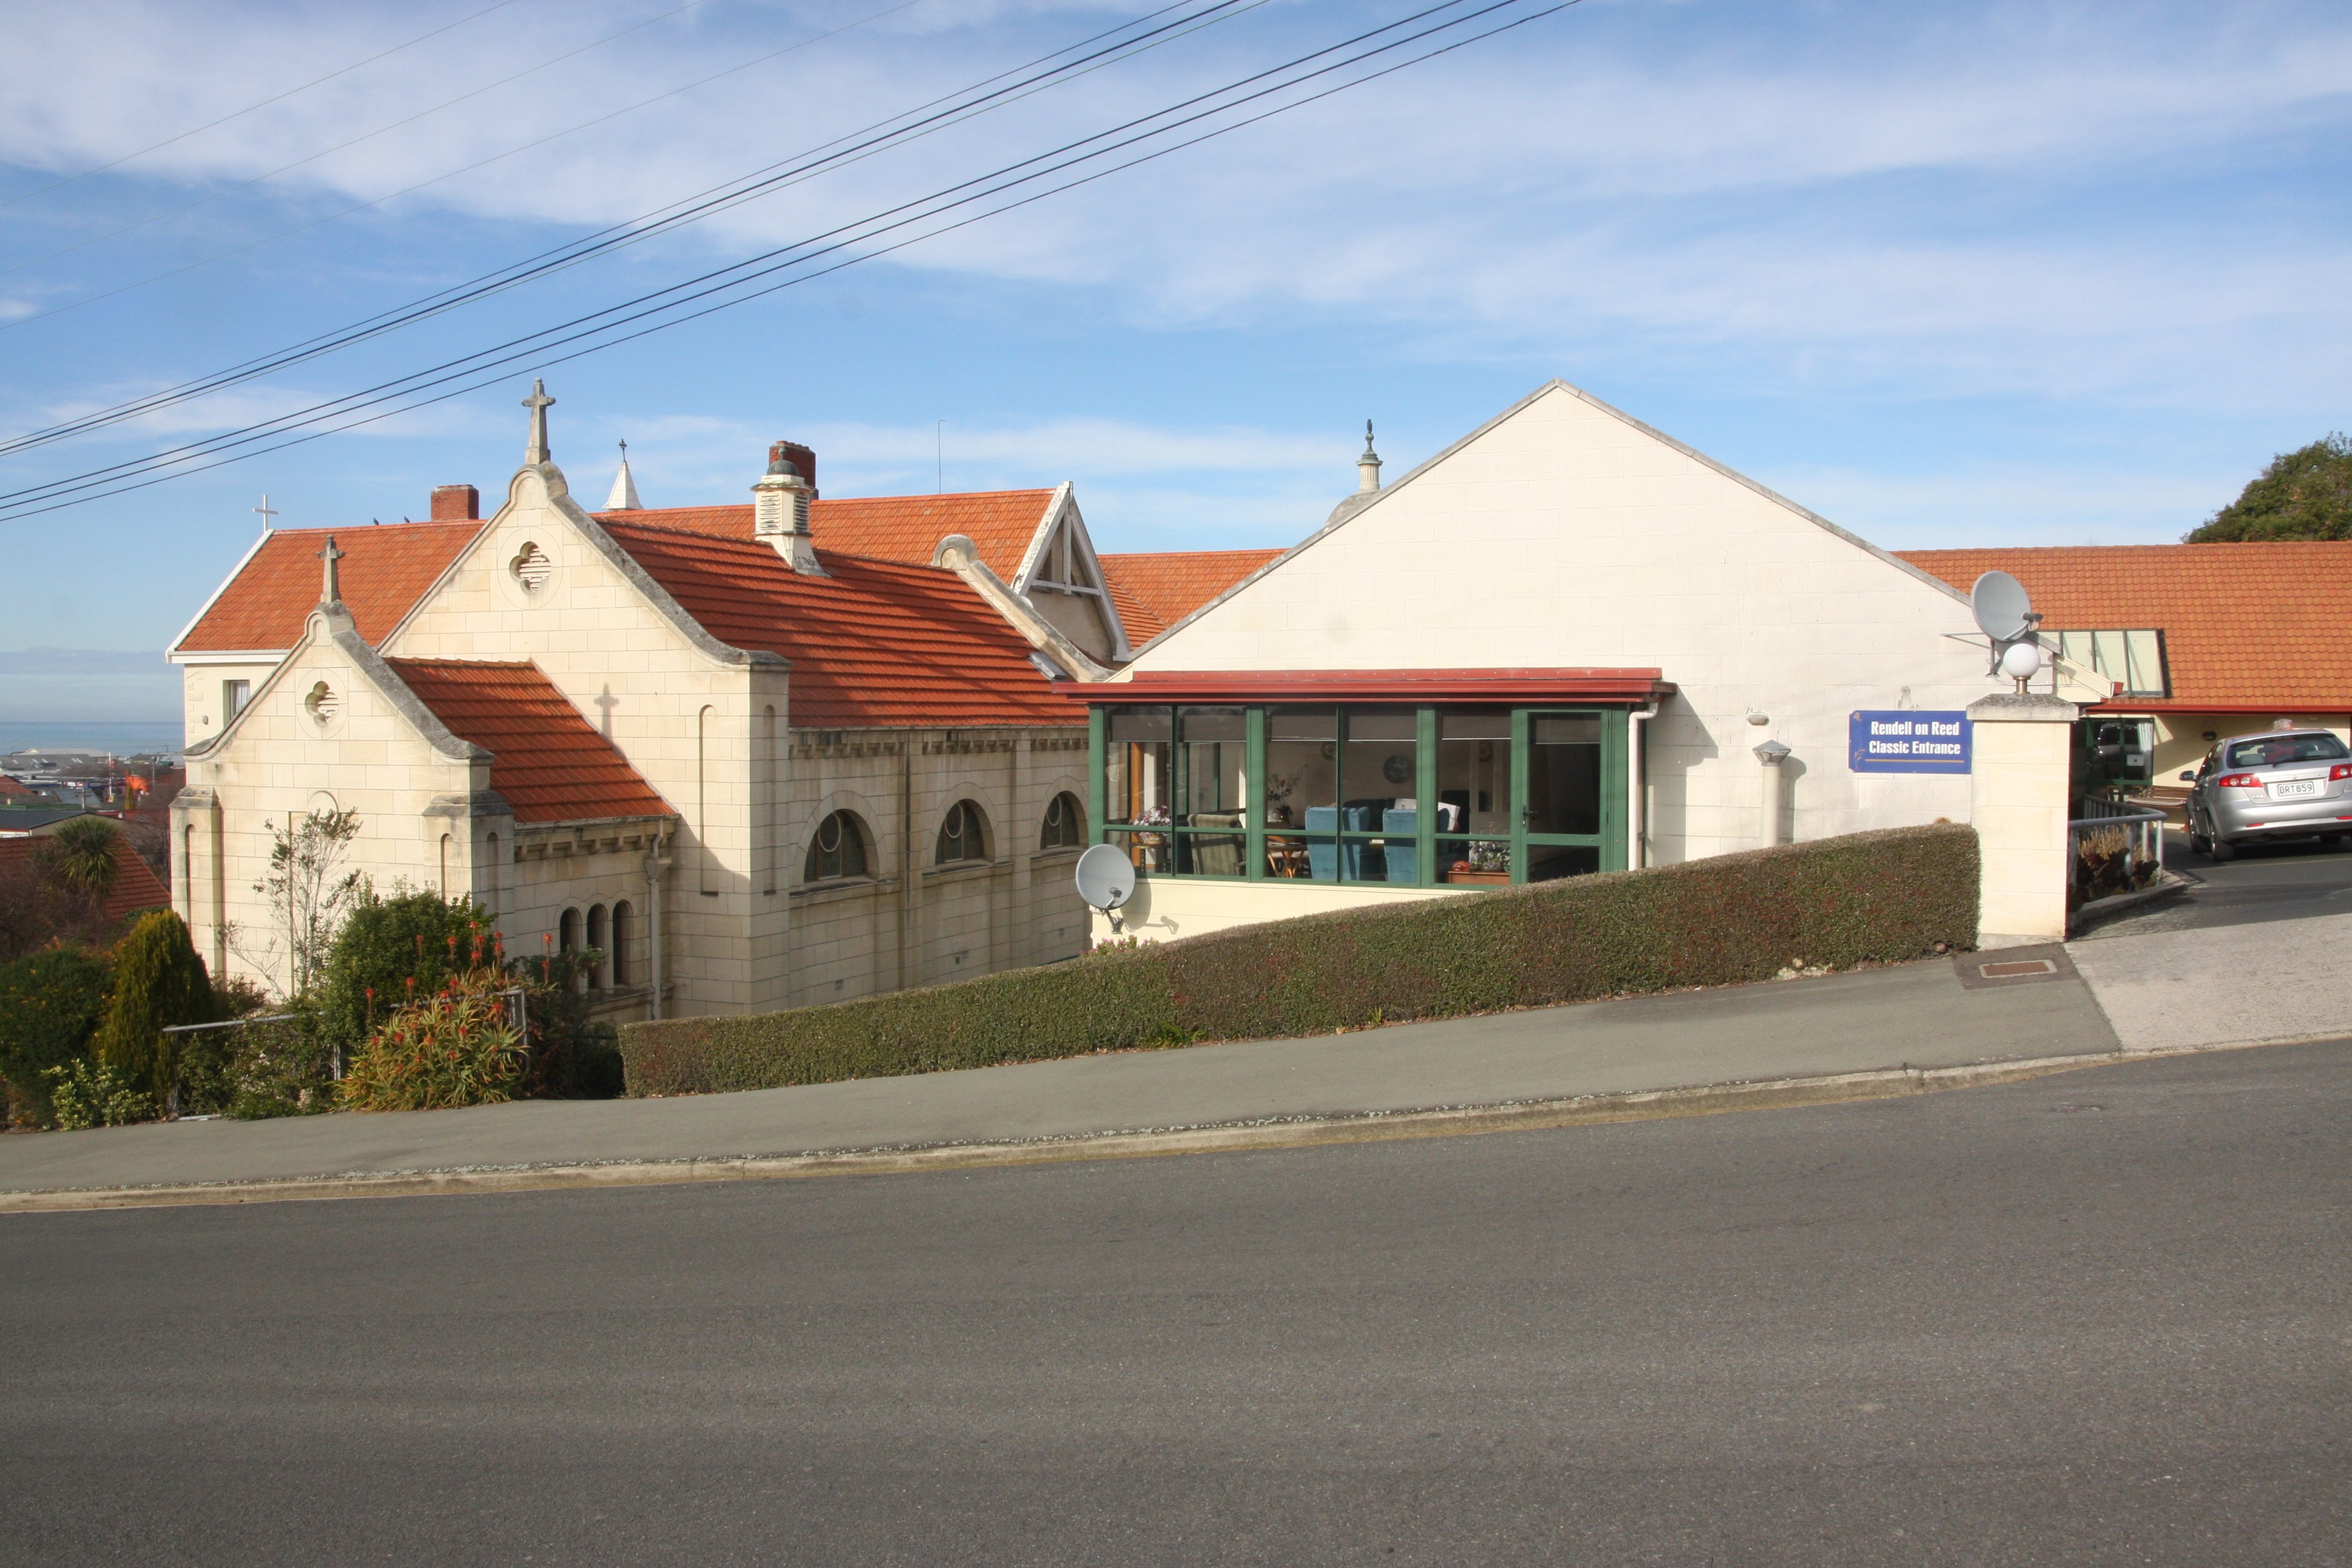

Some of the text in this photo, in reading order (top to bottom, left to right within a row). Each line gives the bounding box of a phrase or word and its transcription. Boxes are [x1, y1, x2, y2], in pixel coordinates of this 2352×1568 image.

[1871, 721, 1959, 736] Rendell on Reed
[1869, 740, 1961, 754] Classic Entrance
[2279, 783, 2312, 794] BRT859
